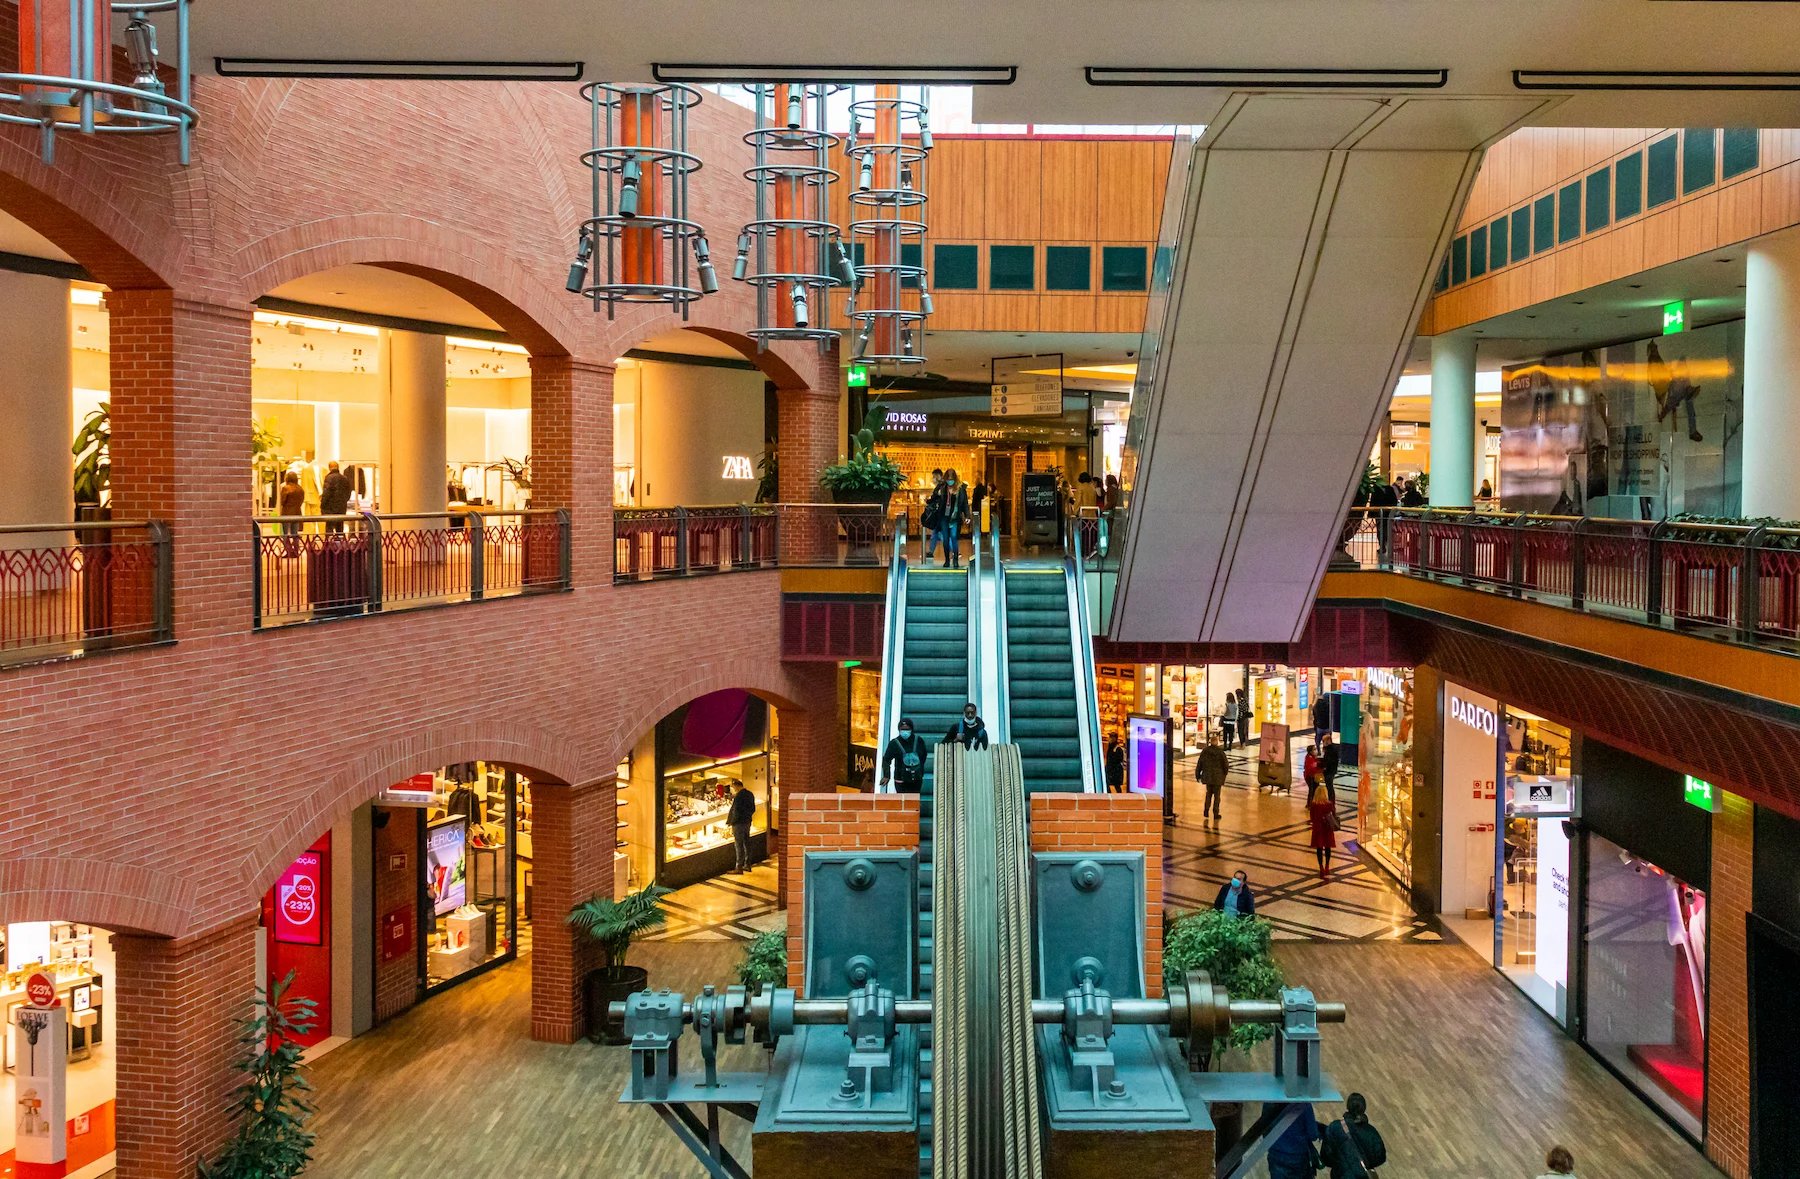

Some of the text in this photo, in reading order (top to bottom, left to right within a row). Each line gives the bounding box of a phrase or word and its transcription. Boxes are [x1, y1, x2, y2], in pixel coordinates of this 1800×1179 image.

[900, 413, 927, 423] ROSAS
[722, 455, 754, 480] ZARA
[285, 900, 311, 911] -23%
[28, 984, 51, 996] -23%
[16, 1010, 49, 1021] LOEWE
